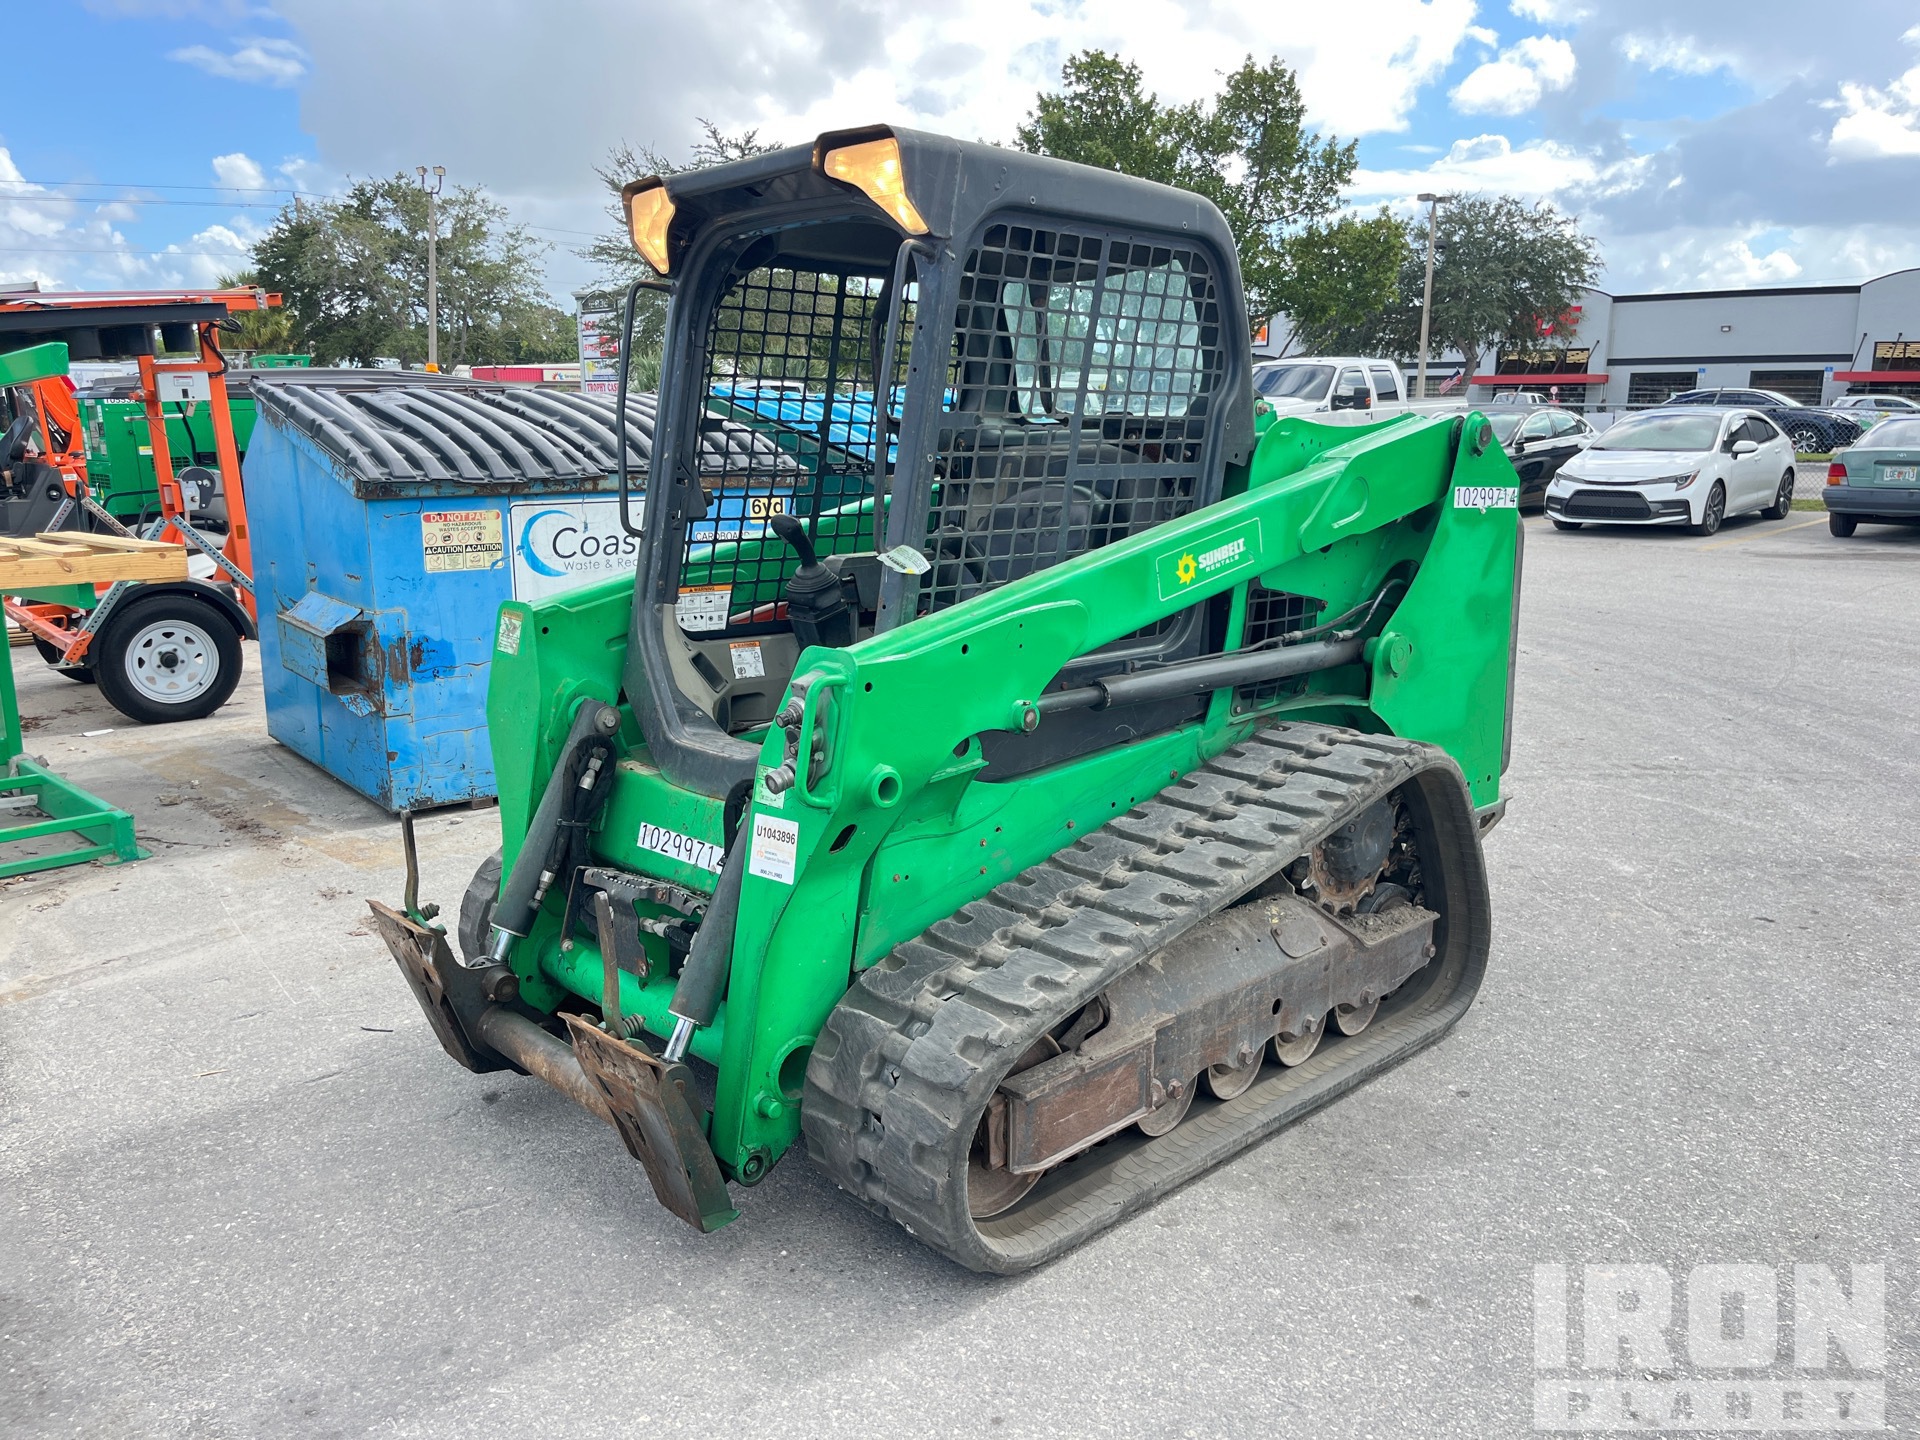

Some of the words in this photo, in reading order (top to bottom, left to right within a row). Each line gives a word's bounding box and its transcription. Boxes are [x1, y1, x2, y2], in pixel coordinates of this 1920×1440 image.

[587, 383, 606, 392] TROPHY
[607, 383, 618, 392] CAS
[1456, 487, 1516, 506] 10299714
[430, 514, 444, 522] DO
[447, 513, 468, 521] NOT
[469, 512, 493, 520] PAR
[552, 527, 636, 559] Coas
[695, 531, 750, 541] CARDBOAD
[472, 544, 501, 552] CAUTION
[1198, 537, 1245, 569] SUNBELT
[564, 560, 600, 570] Waste
[605, 560, 612, 568] &
[618, 557, 637, 568] Rec
[1206, 554, 1239, 572] RENTALS
[756, 825, 796, 845] U1043896
